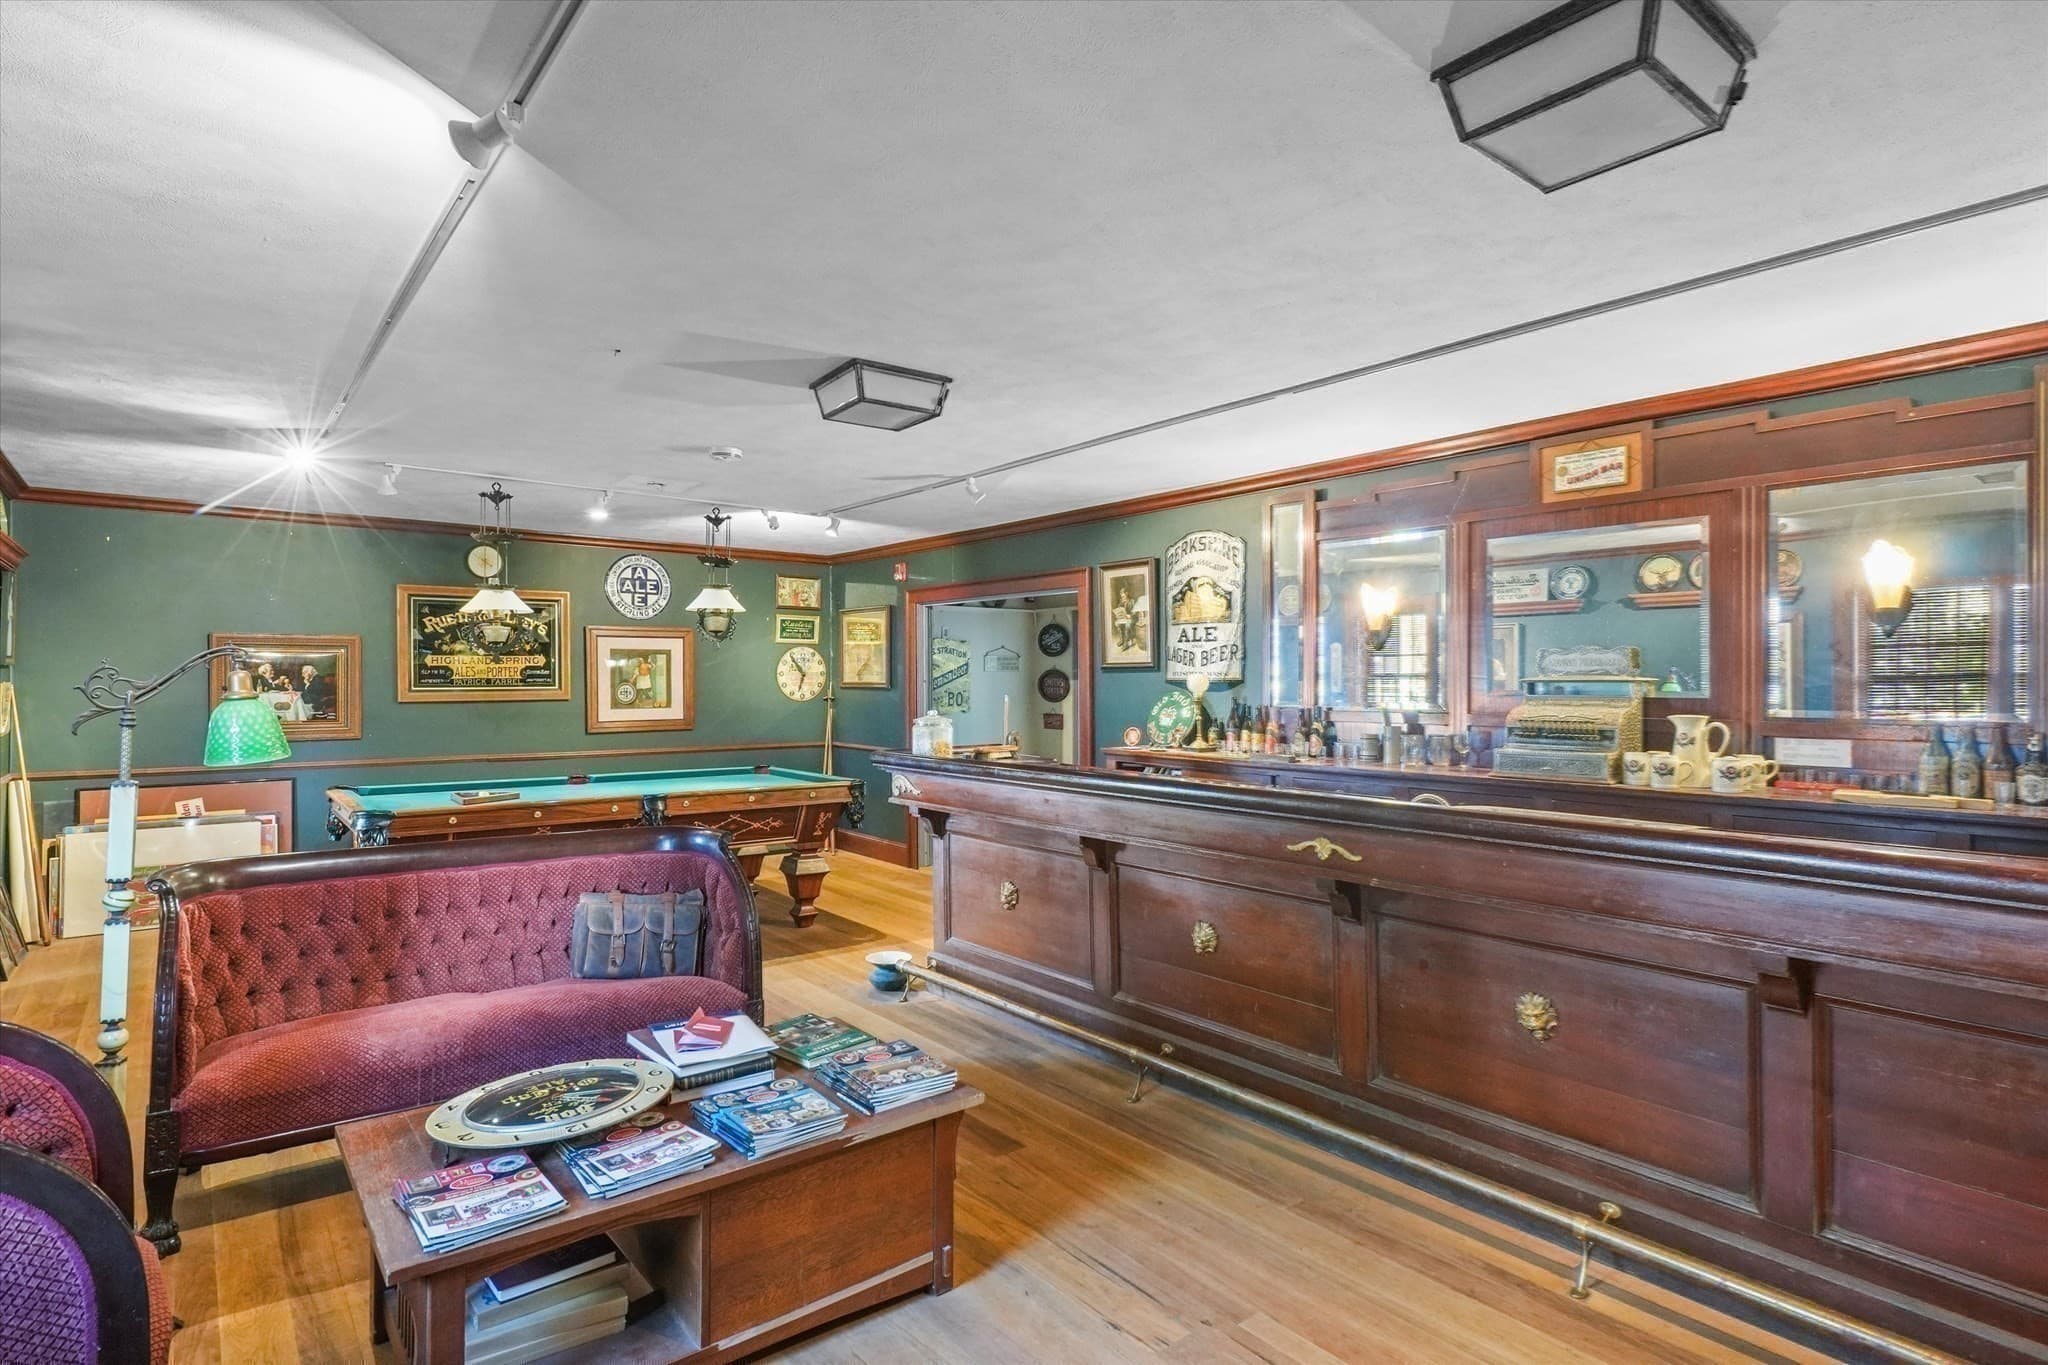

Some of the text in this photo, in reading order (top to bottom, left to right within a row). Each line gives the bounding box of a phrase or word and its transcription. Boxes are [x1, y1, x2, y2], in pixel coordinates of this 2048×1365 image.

[615, 600, 650, 616] STERLING
[1178, 626, 1217, 643] ALE
[937, 646, 967, 659] STRATTON
[1167, 643, 1239, 668] LAGER BEER
[431, 656, 540, 665] HIGHLAND SPRING
[455, 666, 476, 677] ALES
[486, 666, 519, 678] PORTER
[565, 1122, 590, 1133] 12
